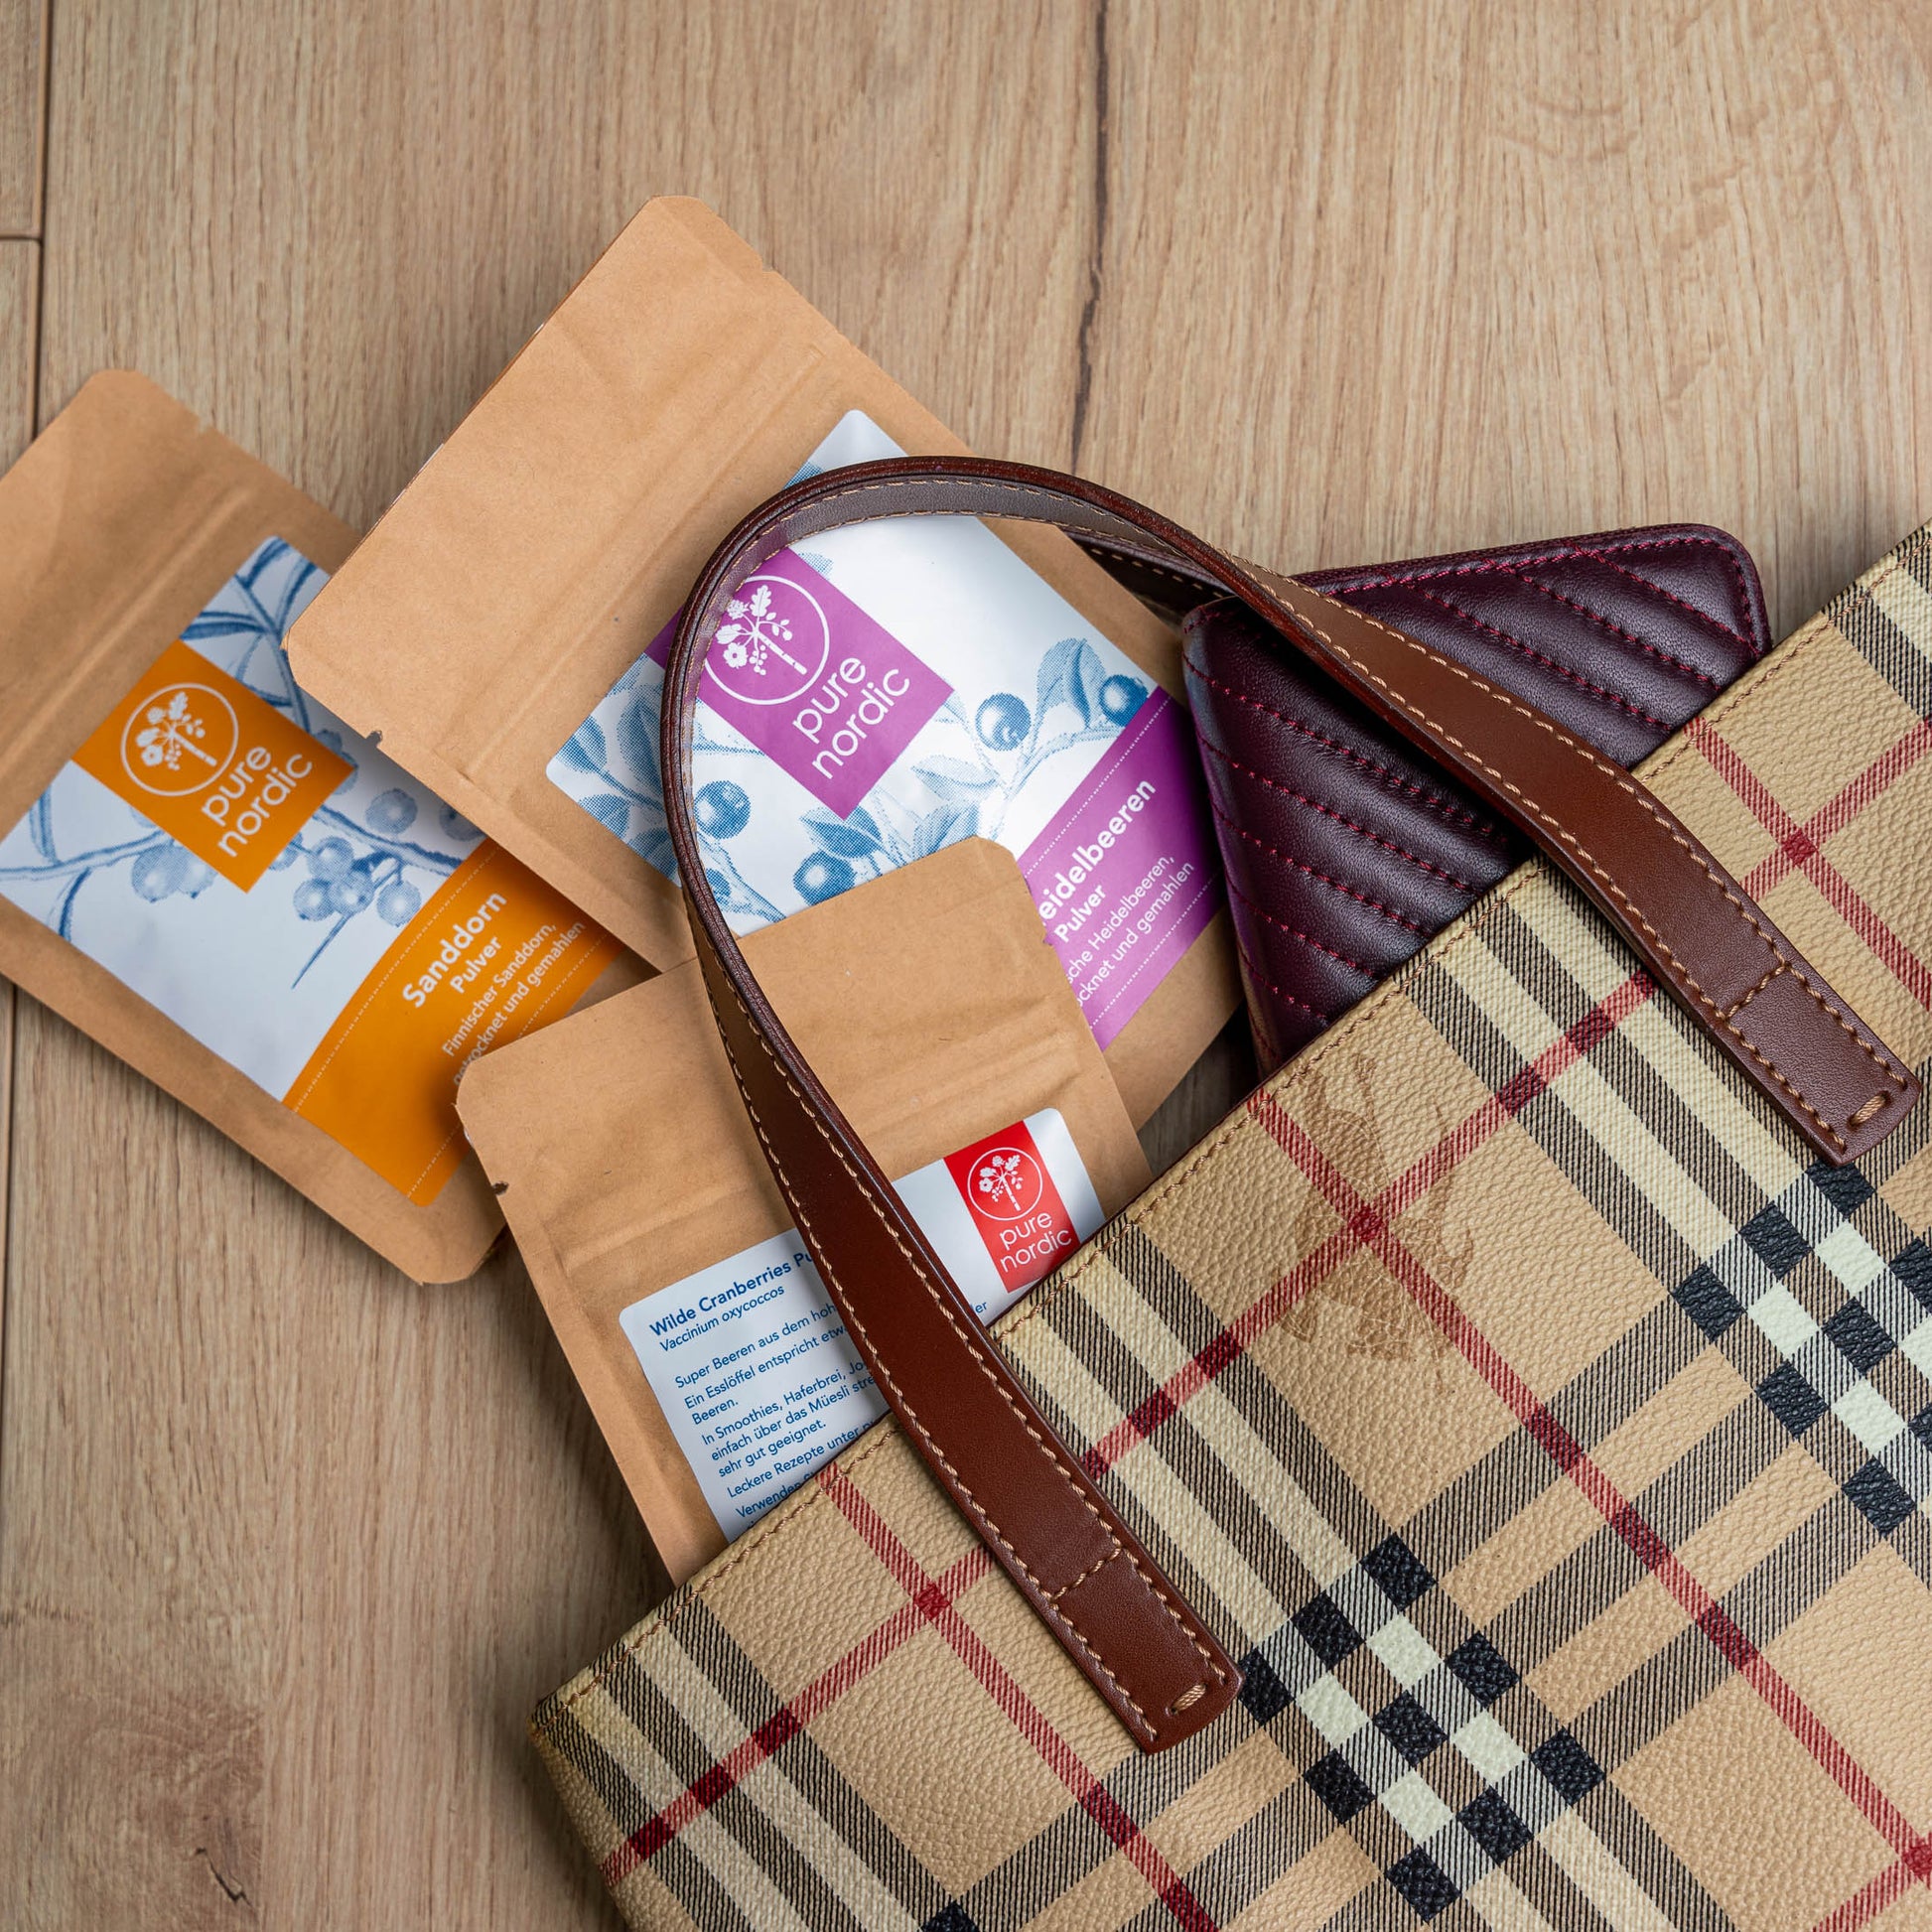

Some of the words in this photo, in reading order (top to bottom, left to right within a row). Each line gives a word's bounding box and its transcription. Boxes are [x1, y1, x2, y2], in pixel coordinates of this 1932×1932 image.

[791, 657, 866, 745] pure
[811, 668, 910, 779] nordic
[202, 747, 272, 827] pure
[216, 754, 313, 858] nordic
[1038, 779, 1156, 925] eidelbeeren
[1053, 885, 1106, 943] Pulver
[1087, 855, 1175, 950] Heidelbeeren,
[1112, 927, 1139, 962] und
[1138, 862, 1195, 935] gemahlen
[402, 893, 507, 1009] Sanddorn
[442, 986, 498, 1057] Finnischer
[492, 922, 557, 988] Sanddorn,
[449, 936, 502, 994] Pulver
[503, 982, 530, 1014] und
[526, 921, 587, 987] gemahlen
[1000, 1212, 1052, 1251] pure
[1000, 1230, 1072, 1273] nordic
[649, 1309, 697, 1336] Wilde
[698, 1262, 792, 1312] Cranberries
[659, 1317, 720, 1352] Vaccinium
[721, 1285, 784, 1322] oxycoccos
[675, 1365, 711, 1388] Super
[712, 1343, 756, 1370] Beeren
[758, 1331, 779, 1348] aus
[781, 1317, 810, 1336] dem
[684, 1393, 705, 1410] Ein
[705, 1365, 757, 1399] Esslöffel
[758, 1336, 820, 1373] entspricht
[821, 1325, 847, 1342] etw
[692, 1398, 739, 1425] Beeren.
[701, 1433, 715, 1446] In
[715, 1402, 783, 1440] Smoothies,
[783, 1369, 846, 1405] Haferbrei,
[849, 1361, 866, 1375] Jo
[711, 1434, 753, 1461] einfach
[755, 1420, 782, 1441] über
[785, 1408, 808, 1425] das
[808, 1385, 851, 1413] Müesli
[718, 1458, 743, 1477] sehr
[745, 1448, 766, 1467] gut
[767, 1419, 826, 1455] geeignet.
[727, 1470, 773, 1498] Leckere
[773, 1446, 825, 1475] Rezepte
[826, 1429, 859, 1449] unter
